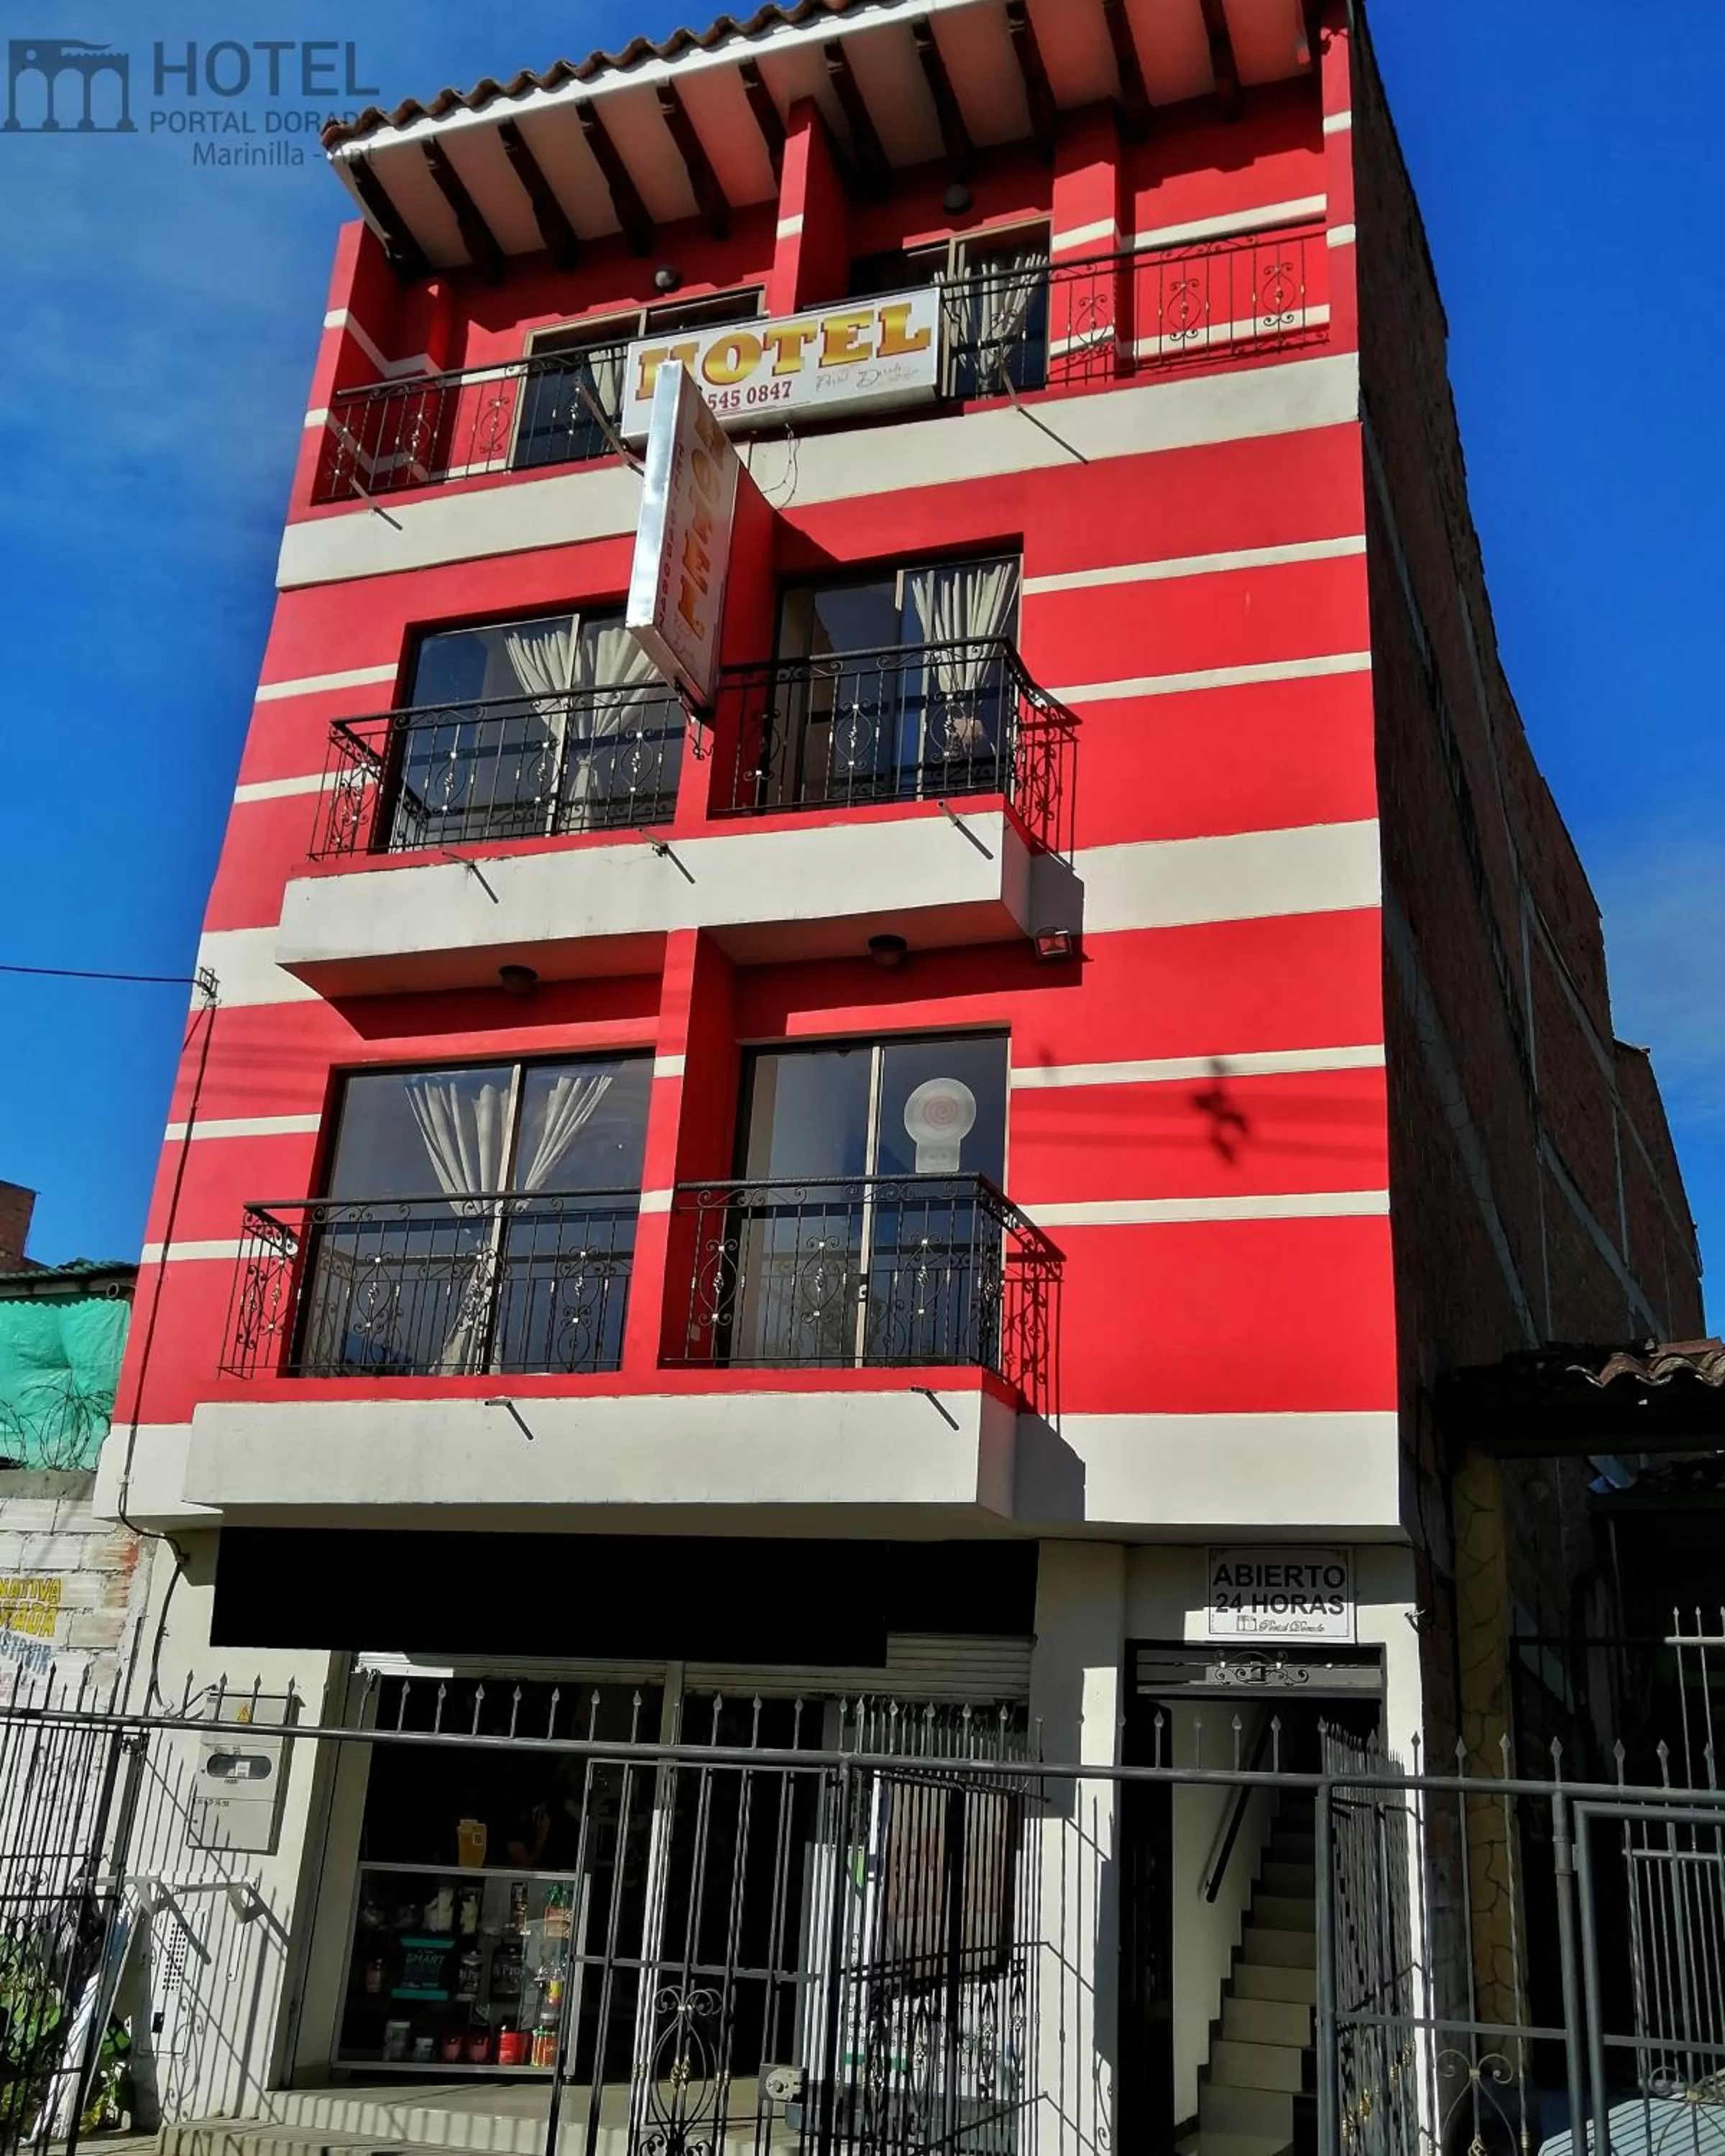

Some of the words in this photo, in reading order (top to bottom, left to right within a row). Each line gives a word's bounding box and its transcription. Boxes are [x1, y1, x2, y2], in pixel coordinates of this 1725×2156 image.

[635, 302, 932, 400] HOTEL
[707, 389, 740, 411] 545
[746, 379, 792, 404] 0847
[1213, 1563, 1346, 1589] ABIERTO
[1215, 1593, 1243, 1613] 24
[1251, 1593, 1345, 1616] HORAS
